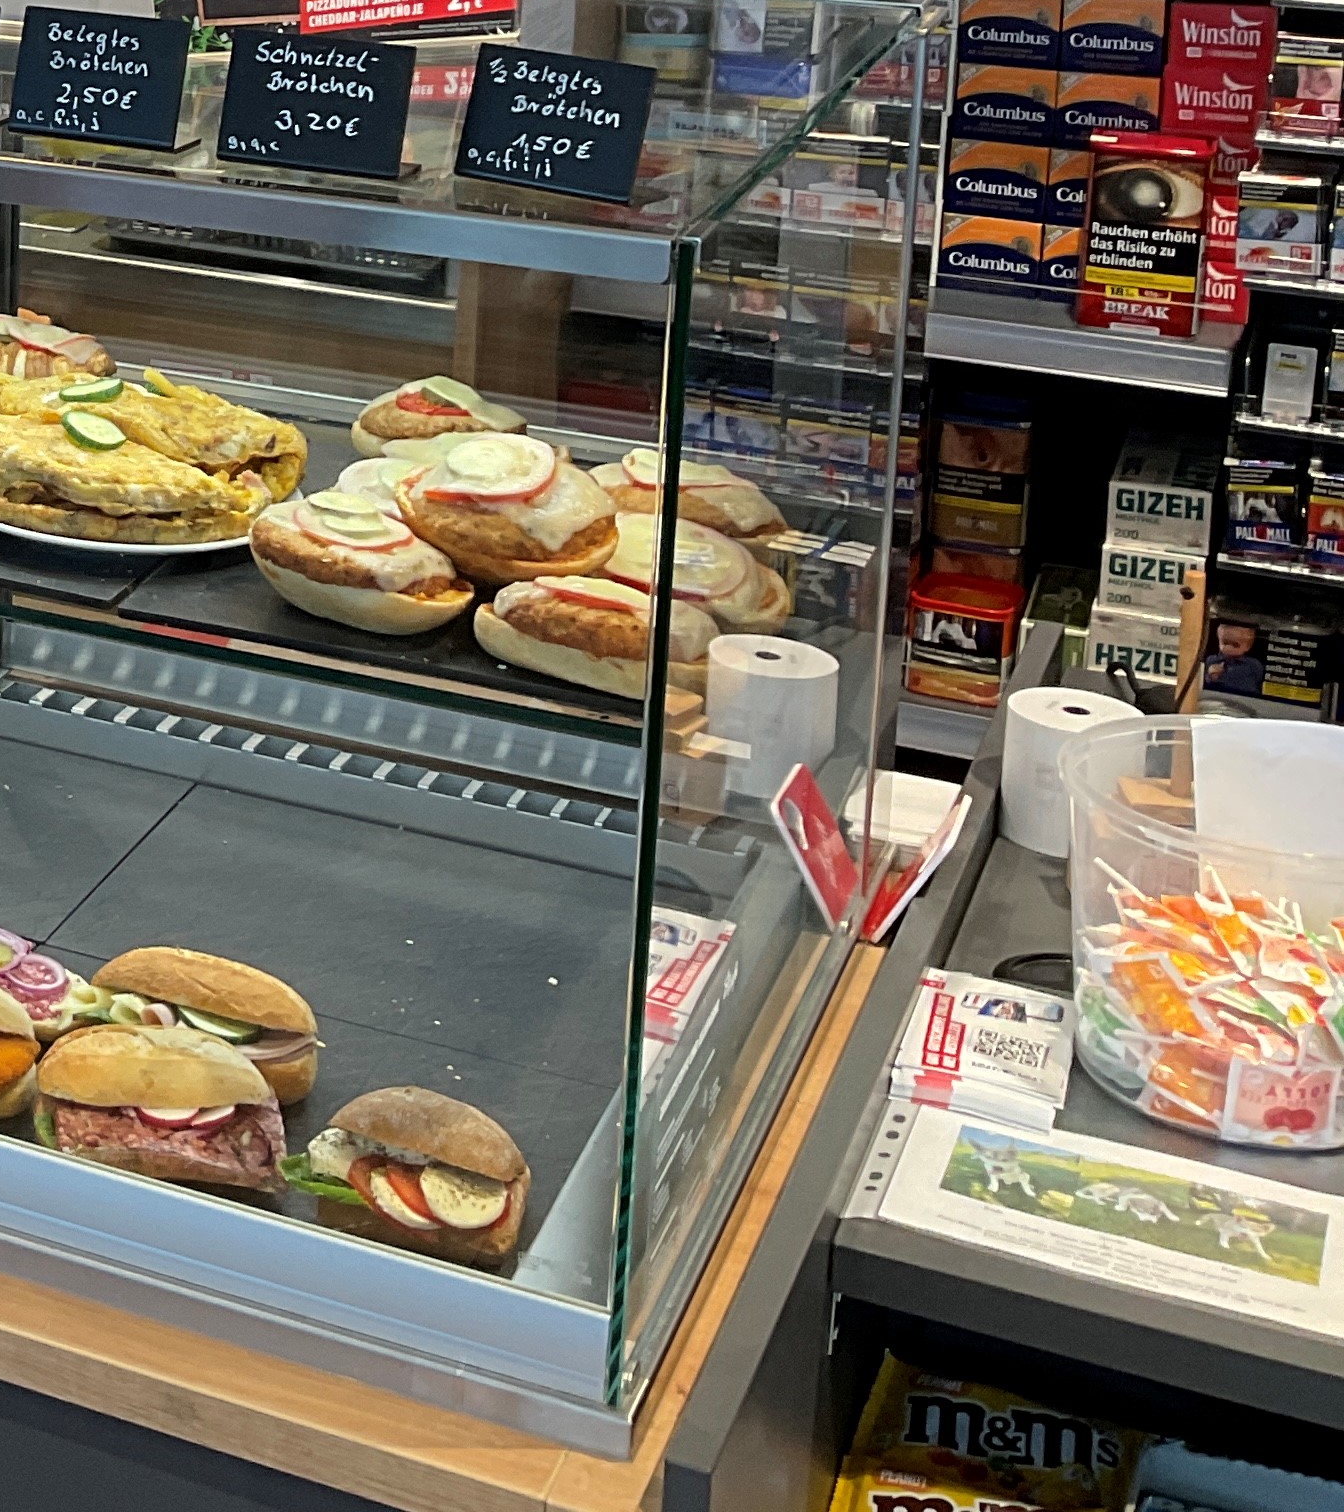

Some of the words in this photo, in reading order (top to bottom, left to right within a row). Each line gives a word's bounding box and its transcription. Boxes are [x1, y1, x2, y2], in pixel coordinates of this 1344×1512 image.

[412, 3, 424, 16] JE
[48, 22, 140, 55] Belegtes
[1070, 33, 1154, 52] Columbus
[1183, 19, 1261, 46] Winston
[49, 50, 149, 78] Brötchen
[255, 41, 380, 73] Schnitzel-
[267, 70, 374, 103] Brötchen
[514, 60, 603, 96] Belegtes
[56, 83, 139, 110] 2,50€
[511, 93, 620, 129] Brötchen
[1092, 222, 1148, 238] Rauchen
[1152, 228, 1197, 244] erhöht
[1089, 252, 1152, 269] erblinden
[1091, 237, 1113, 252] das
[1117, 240, 1156, 256] Risiko
[1160, 246, 1175, 257] zu
[948, 252, 1029, 274] Columbus
[1103, 301, 1169, 320] BREAK
[1115, 488, 1204, 521] GIZEH
[1236, 526, 1257, 541] PALL
[1267, 528, 1291, 543] MALL
